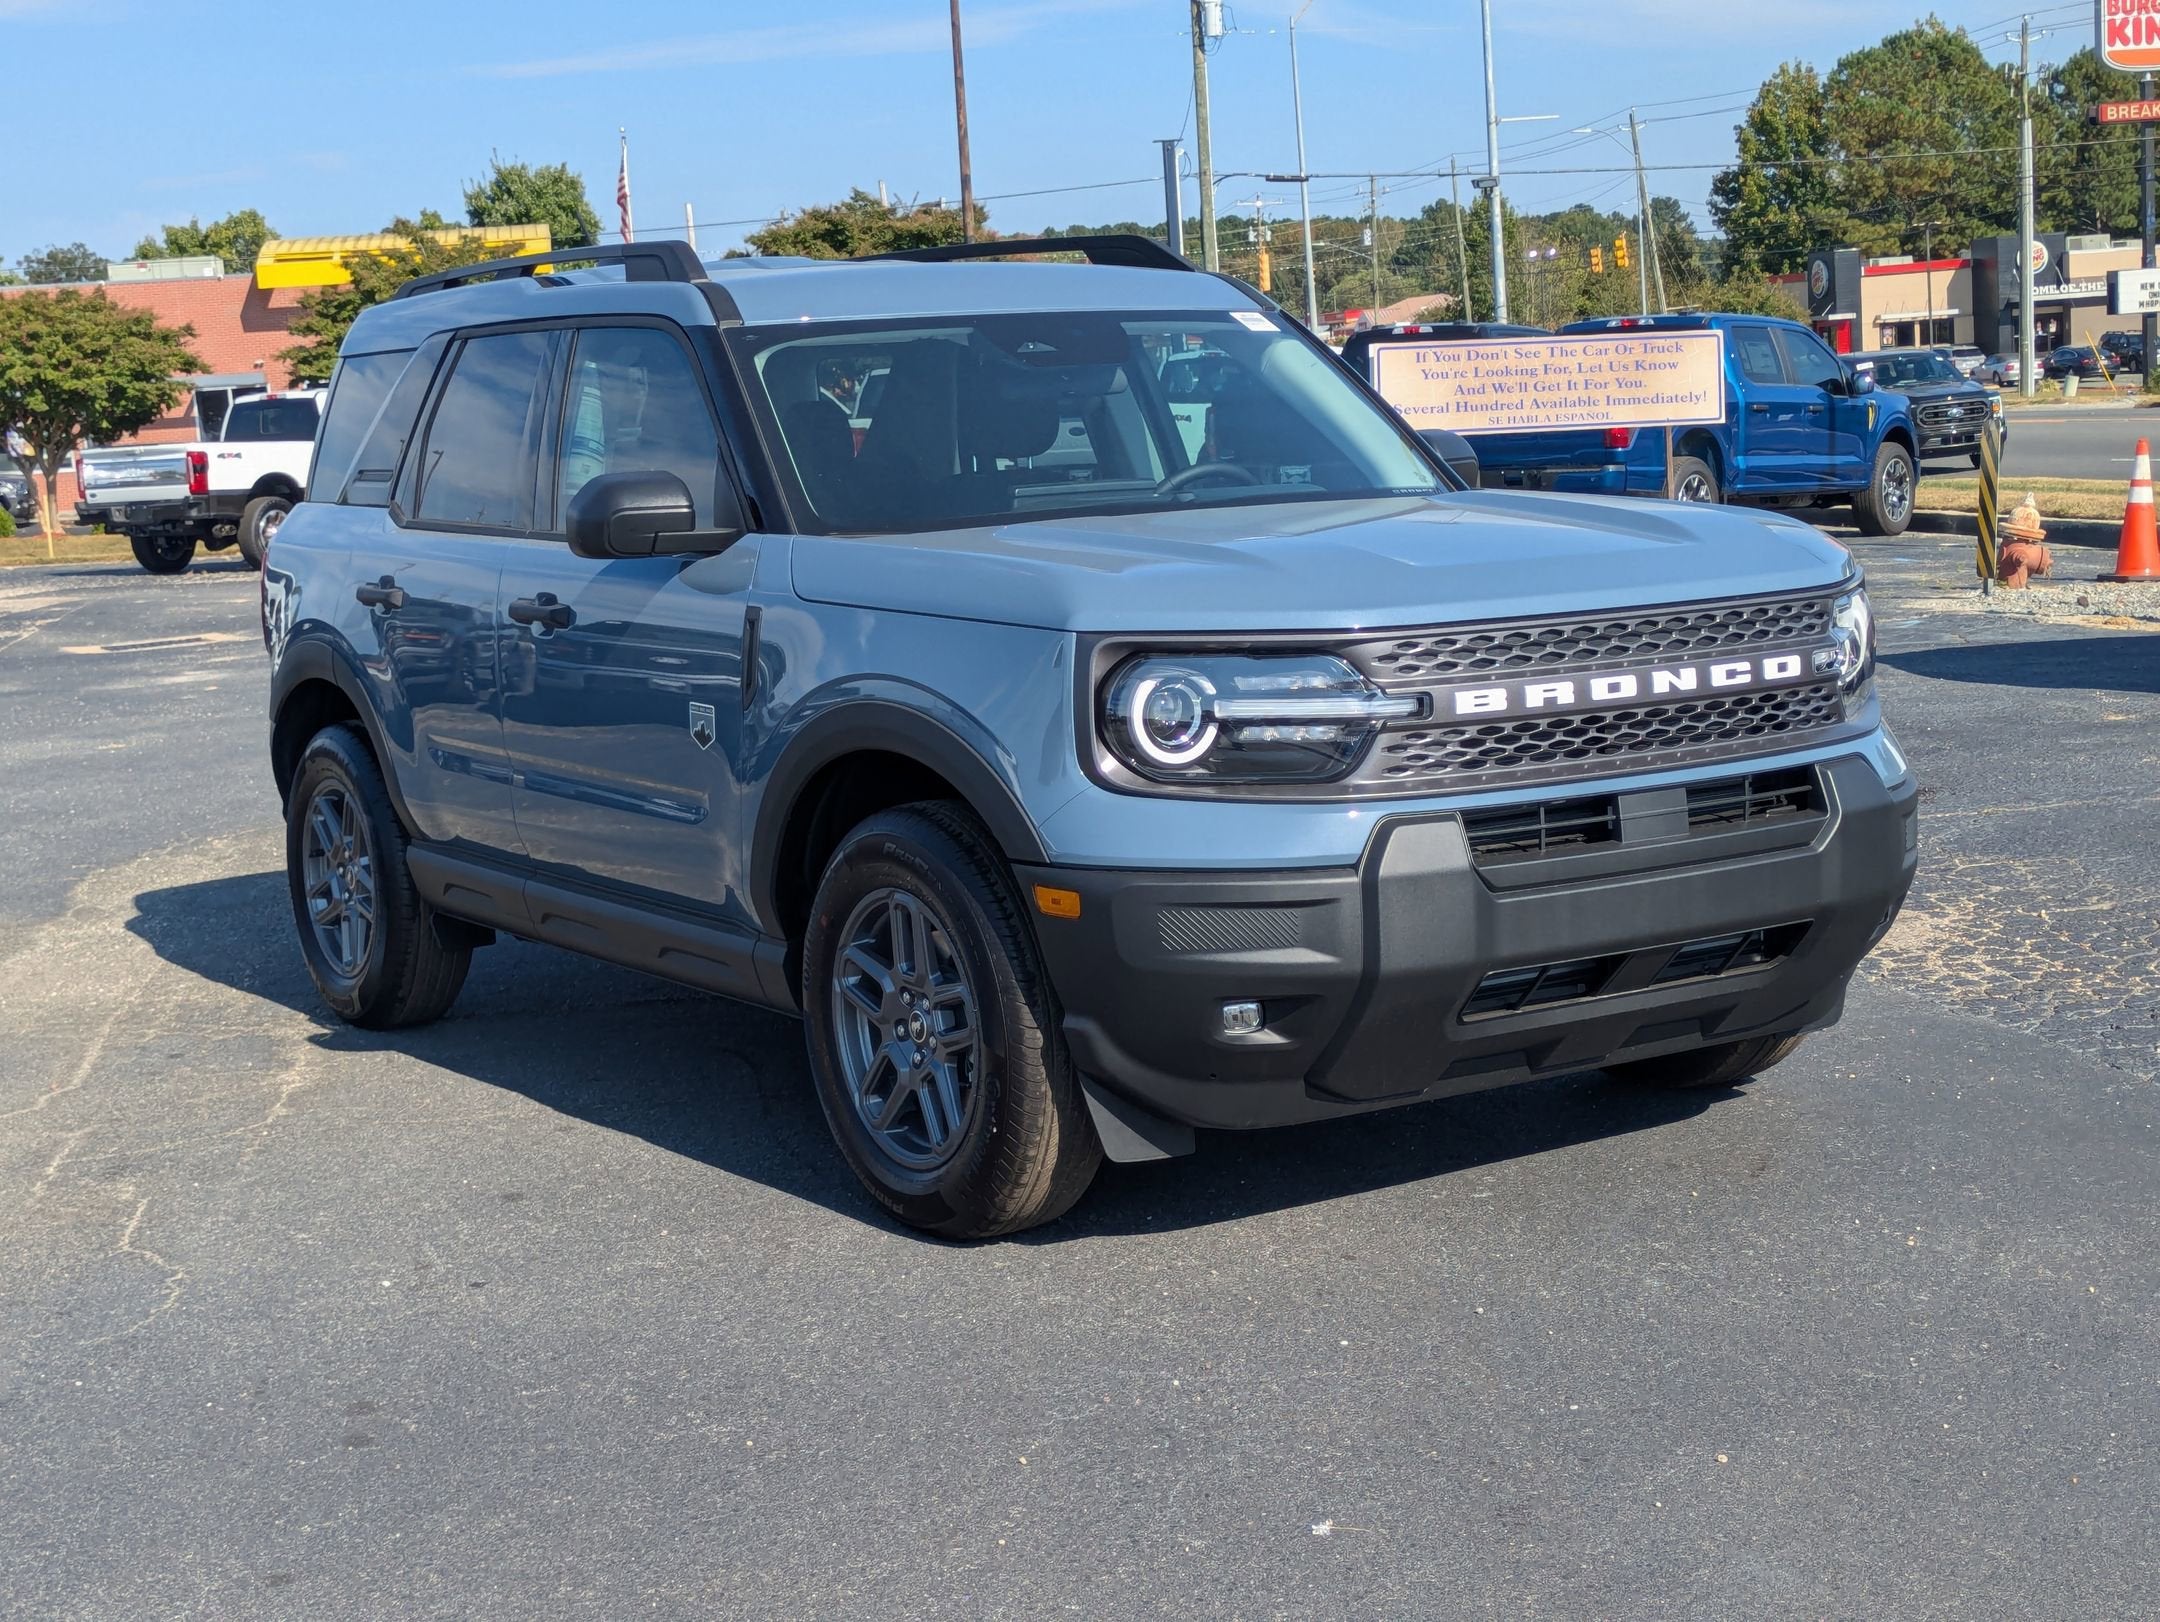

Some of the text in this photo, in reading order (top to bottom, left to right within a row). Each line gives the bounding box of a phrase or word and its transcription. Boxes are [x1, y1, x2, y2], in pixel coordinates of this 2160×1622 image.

[2107, 16, 2160, 47] KIN
[2107, 103, 2160, 120] BREAK
[2033, 284, 2059, 295] OME
[2060, 283, 2080, 293] OF
[1416, 342, 1684, 363] If You Don't See The Car Or Truck
[1421, 359, 1679, 380] You're Looking For, Let Us Know
[1454, 377, 1647, 396] And We'll Get It For You.
[1394, 391, 1707, 415] Several Hundred Available Immediately!
[1488, 416, 1503, 425] SE
[1507, 414, 1551, 424] HABLA
[1454, 654, 1802, 715] BRONCO
